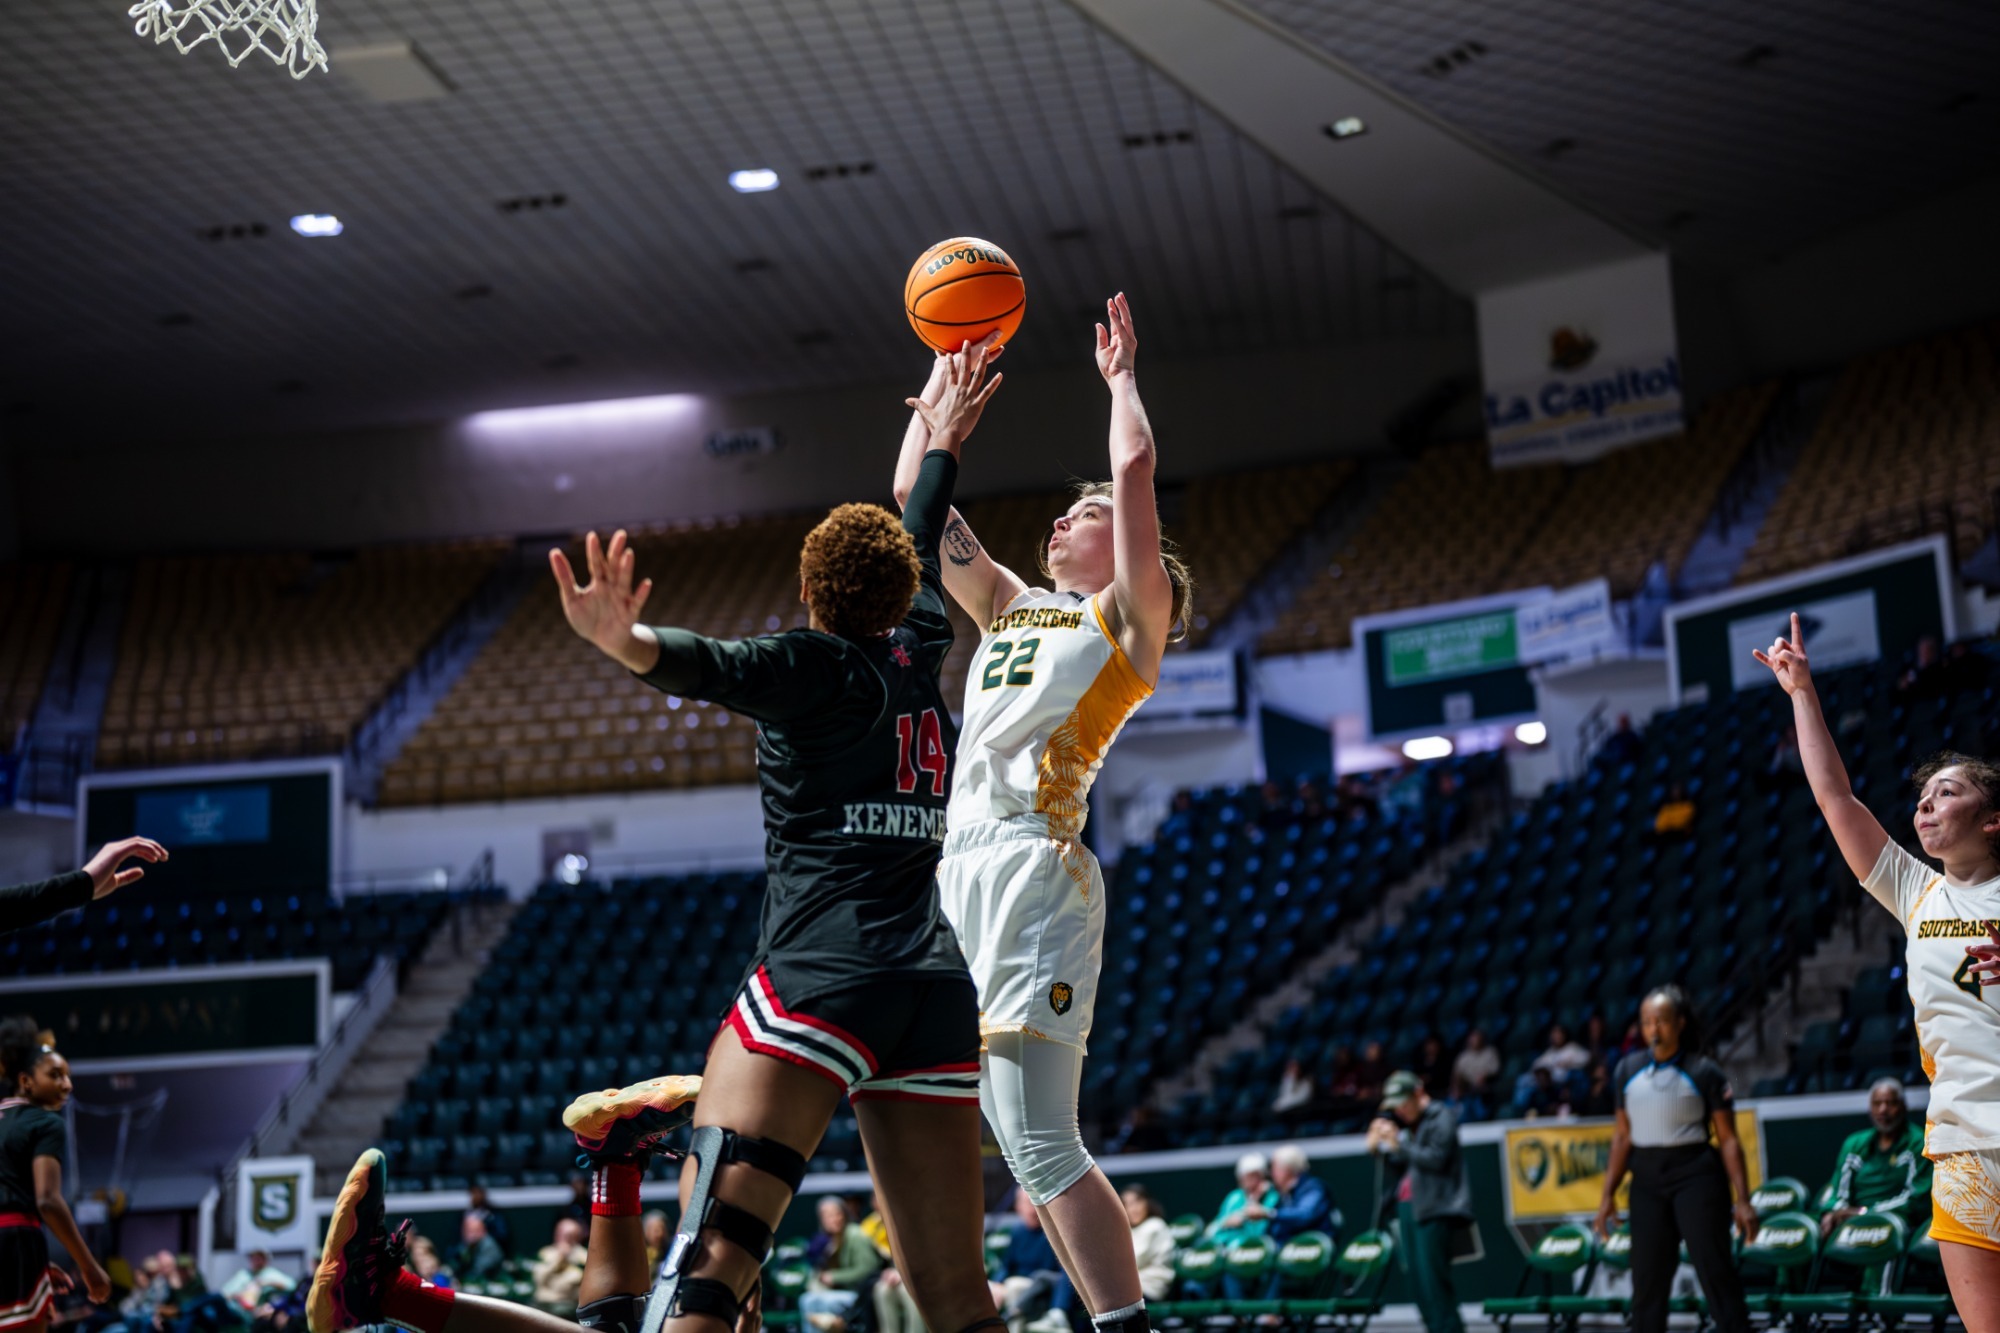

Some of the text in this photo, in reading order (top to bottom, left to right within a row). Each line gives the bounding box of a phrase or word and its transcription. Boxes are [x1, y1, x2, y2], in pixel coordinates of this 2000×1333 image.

[926, 247, 1010, 275] Wilson
[1485, 357, 1681, 427] La Capitol
[987, 608, 1083, 634] OHEASTERN
[981, 637, 1042, 692] 22
[896, 707, 948, 797] 14
[1952, 953, 1983, 1002] 4
[261, 1183, 290, 1219] S
